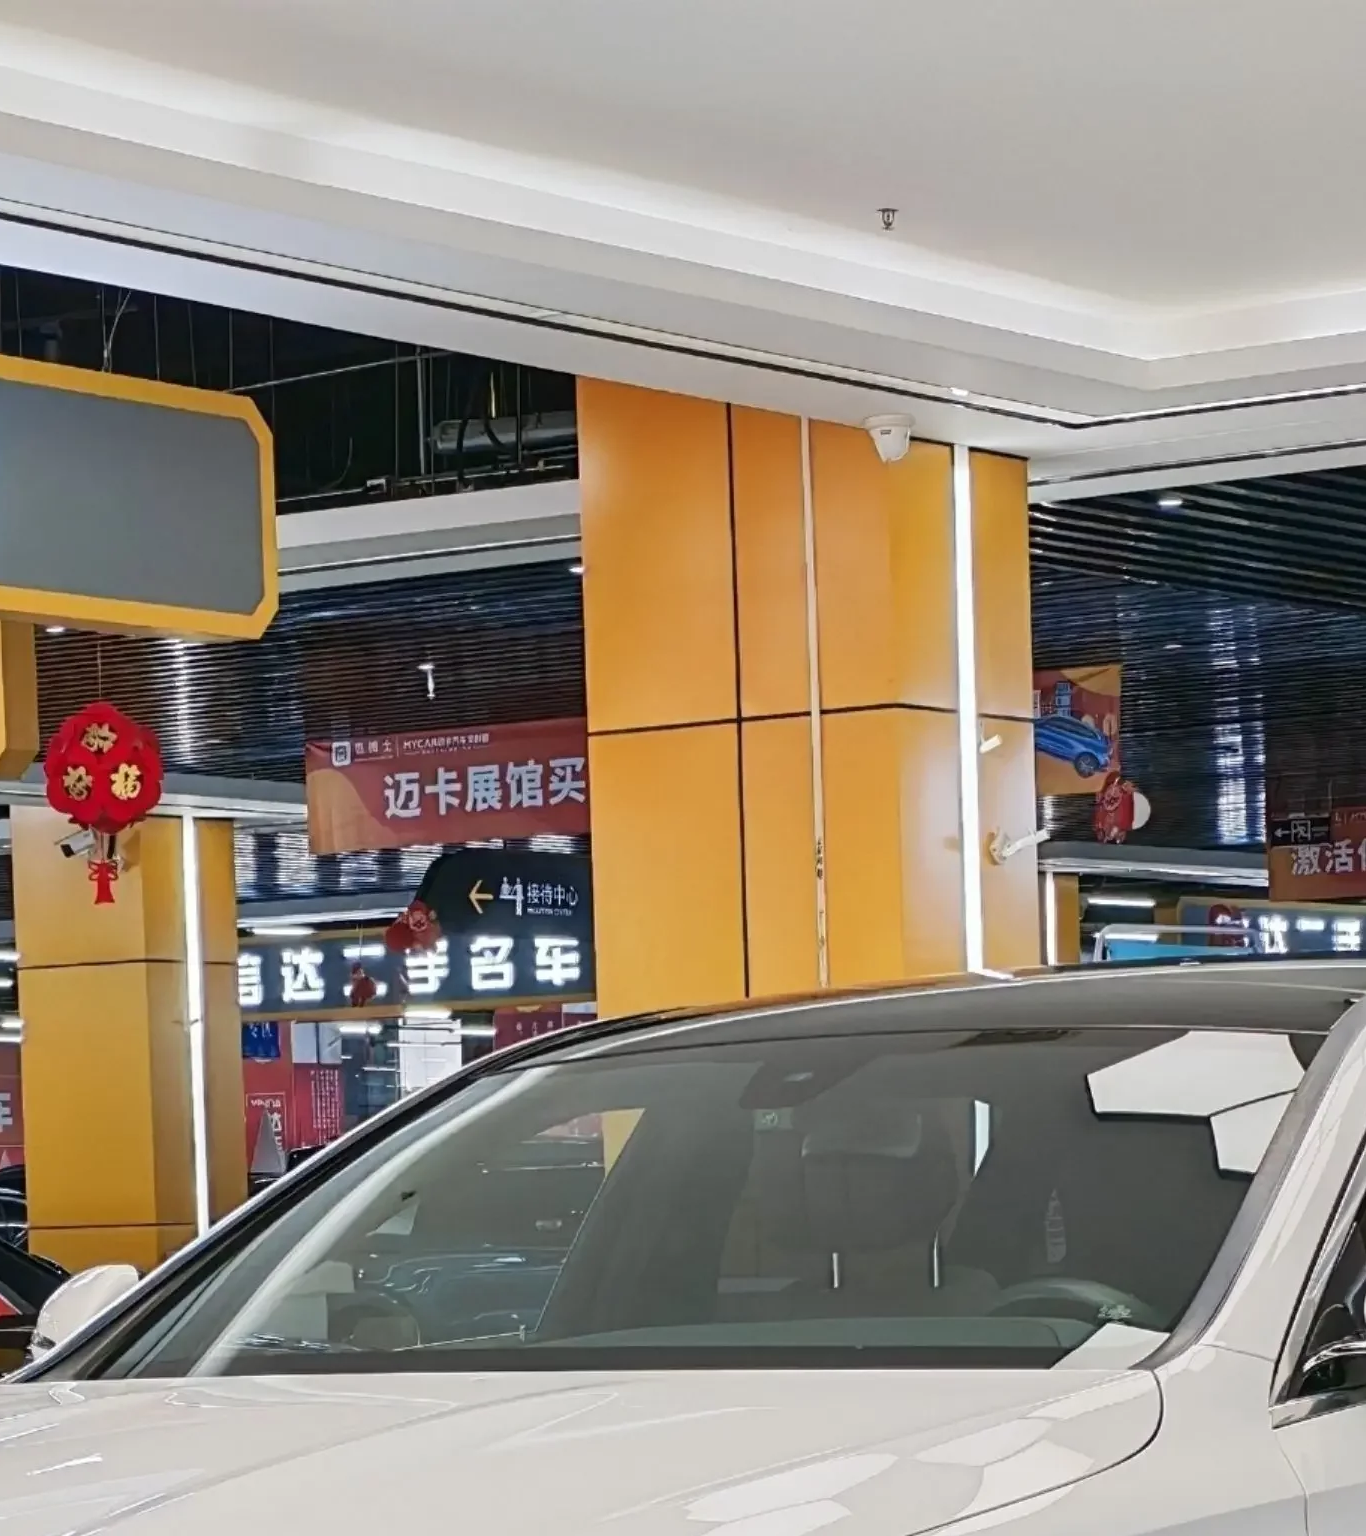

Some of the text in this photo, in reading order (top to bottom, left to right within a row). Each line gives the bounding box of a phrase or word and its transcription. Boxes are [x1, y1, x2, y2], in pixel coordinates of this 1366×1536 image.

[384, 757, 585, 819] 迈卡展馆买
[527, 881, 579, 906] 接待中心
